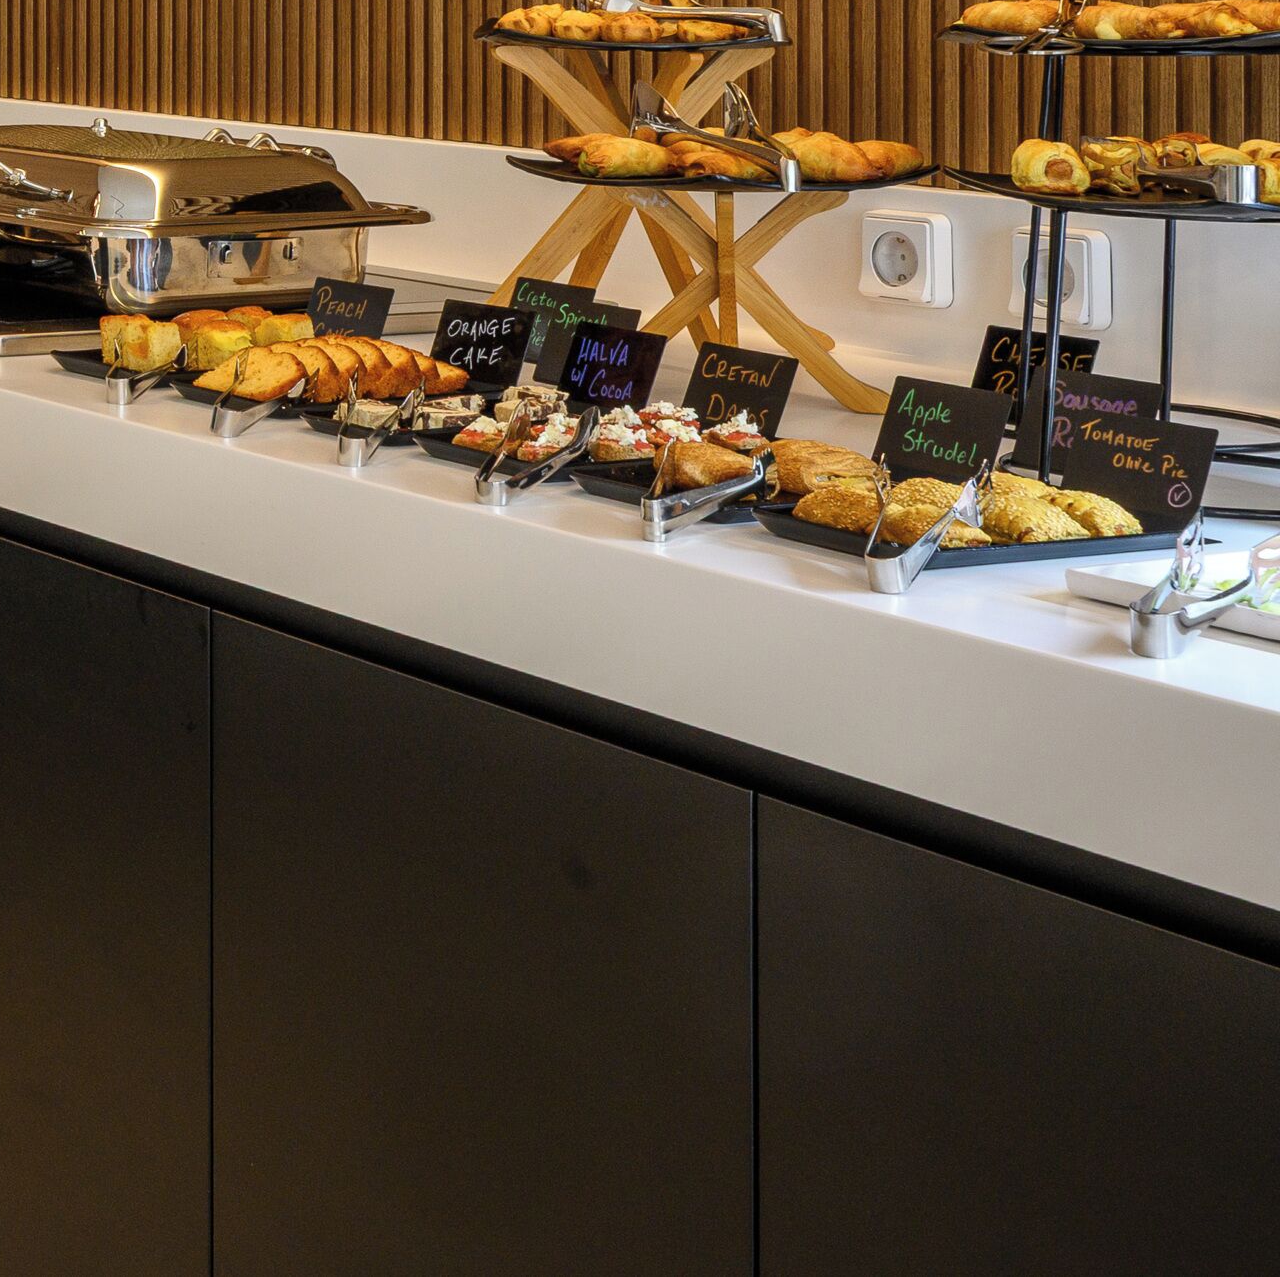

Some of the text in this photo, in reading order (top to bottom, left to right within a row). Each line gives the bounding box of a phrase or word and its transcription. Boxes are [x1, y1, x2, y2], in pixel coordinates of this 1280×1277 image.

[316, 285, 368, 321] PEACH
[447, 317, 515, 342] ORANGE
[449, 345, 504, 371] CAKE
[577, 337, 630, 367] HALVA
[991, 336, 1093, 372] CHESE
[702, 353, 784, 388] CRETAN
[705, 393, 769, 431] DAOS
[897, 388, 951, 427] Apple
[901, 428, 978, 468] Strudel
[1080, 418, 1161, 452] TOMATOE
[1112, 453, 1189, 480] Olive Pie
